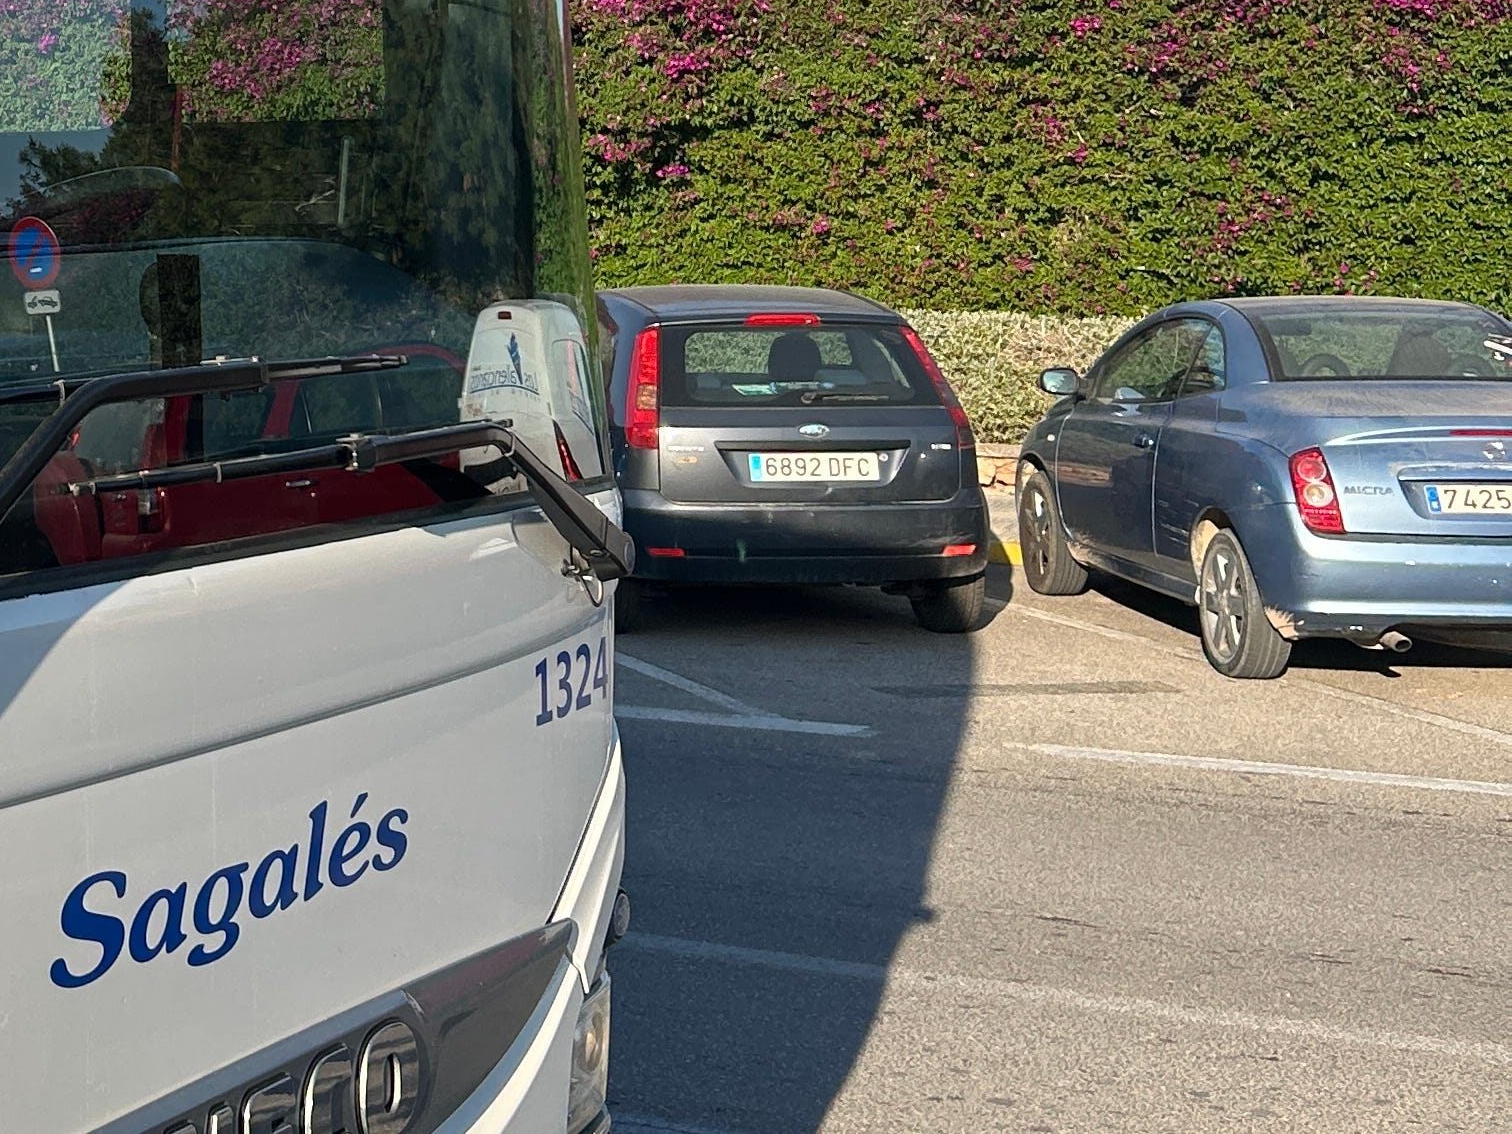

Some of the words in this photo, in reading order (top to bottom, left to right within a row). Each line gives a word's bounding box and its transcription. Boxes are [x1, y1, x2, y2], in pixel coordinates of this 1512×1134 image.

[765, 457, 822, 477] 6892
[828, 457, 870, 477] DFC
[1443, 489, 1512, 510] 7425
[535, 636, 608, 726] 1324
[49, 792, 409, 988] Sagalés
